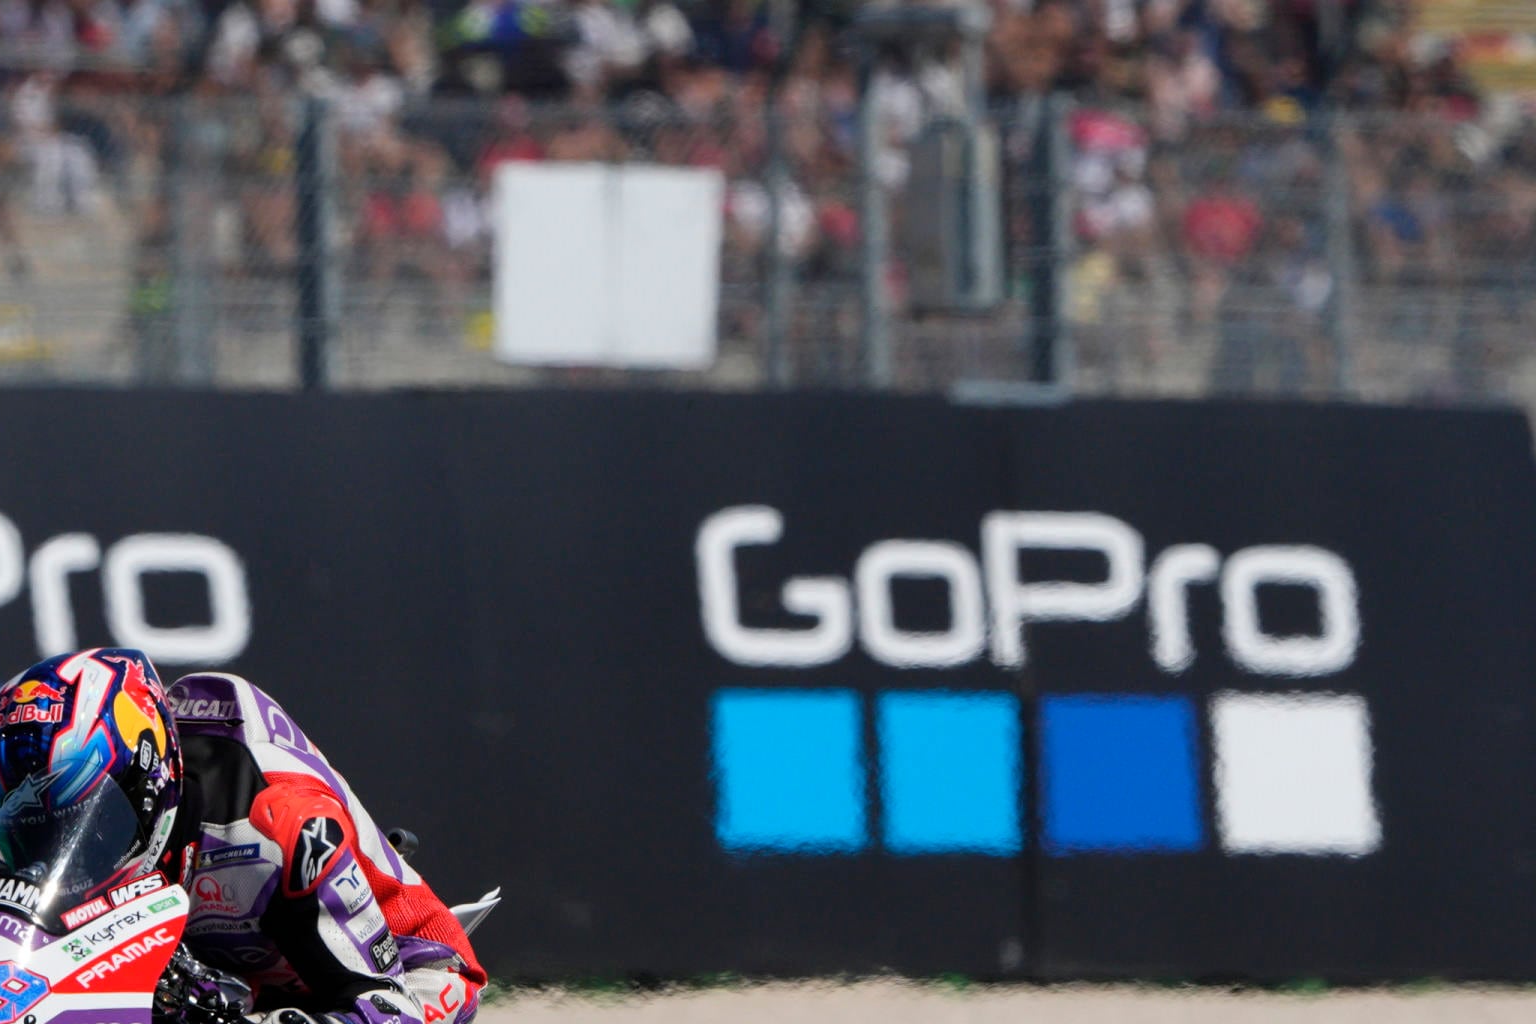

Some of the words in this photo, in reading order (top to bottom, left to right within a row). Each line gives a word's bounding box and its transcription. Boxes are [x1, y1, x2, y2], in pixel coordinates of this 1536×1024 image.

[695, 503, 1362, 676] GoPro
[21, 702, 64, 723] Bull
[110, 873, 163, 907] WRS
[349, 887, 371, 911] randsta
[64, 899, 109, 928] MOTUL
[84, 911, 146, 945] kyrrex
[75, 928, 176, 989] PRAMAC
